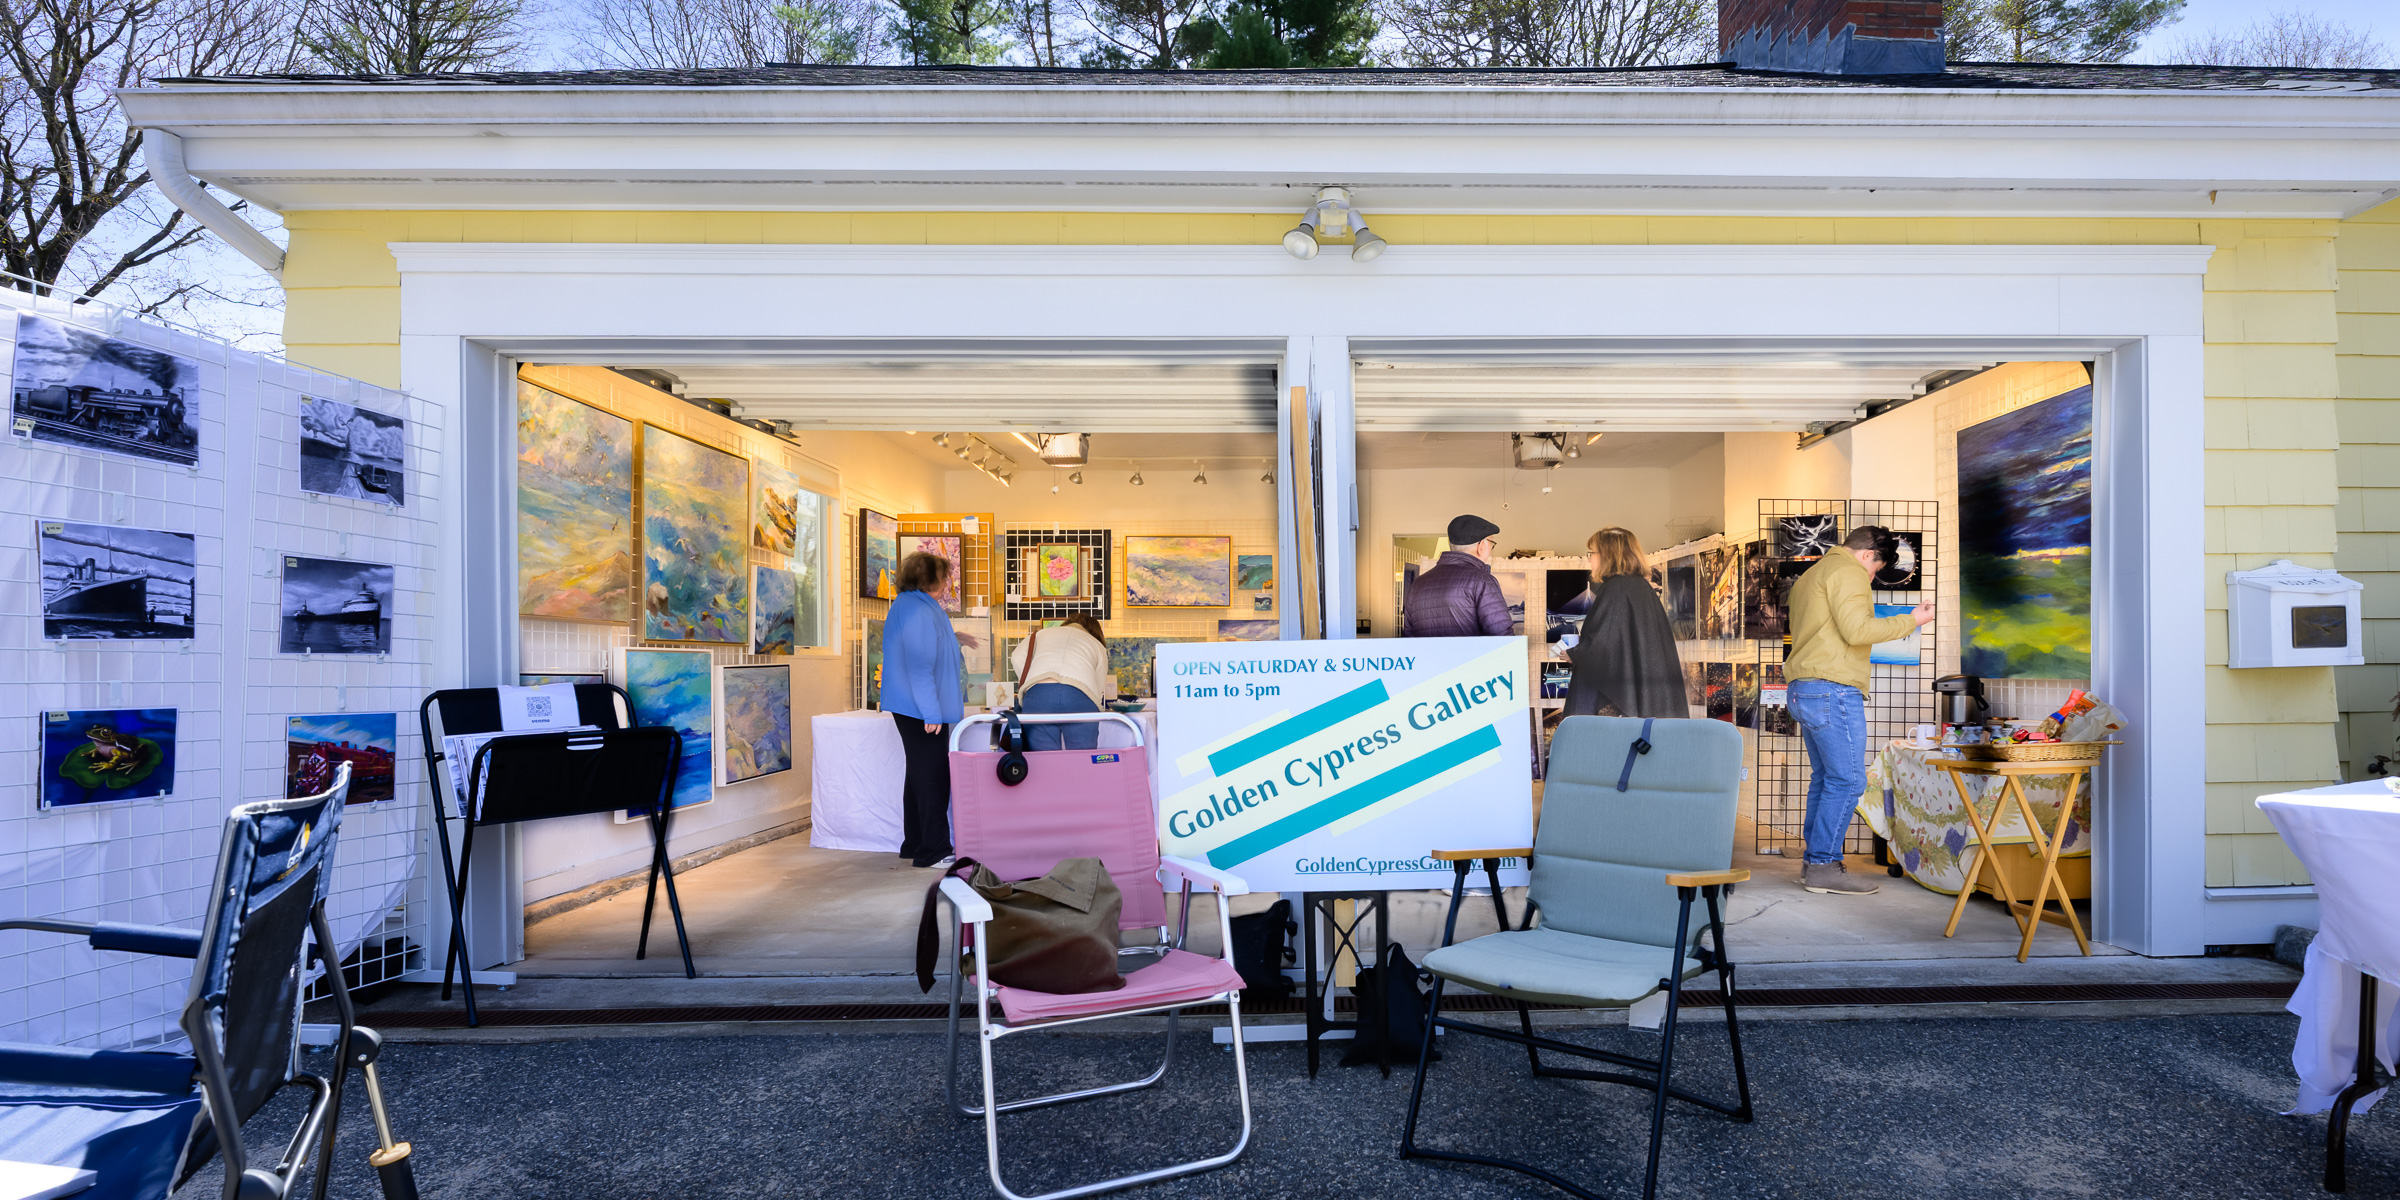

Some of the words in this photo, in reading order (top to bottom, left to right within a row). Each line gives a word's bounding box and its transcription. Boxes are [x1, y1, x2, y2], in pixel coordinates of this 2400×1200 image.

[1173, 661, 1221, 676] OPEN
[1227, 658, 1319, 675] SATURDAY
[1323, 658, 1337, 673] &
[1342, 656, 1416, 672] SUNDAY
[1174, 684, 1218, 698] 11am
[1223, 684, 1240, 698] to
[1245, 682, 1281, 701] 5pm
[1168, 779, 1279, 839] Golden
[1284, 723, 1402, 788] Cypress
[1407, 670, 1514, 731] Gallery
[1295, 855, 1517, 875] GoldenCypressGally.m
